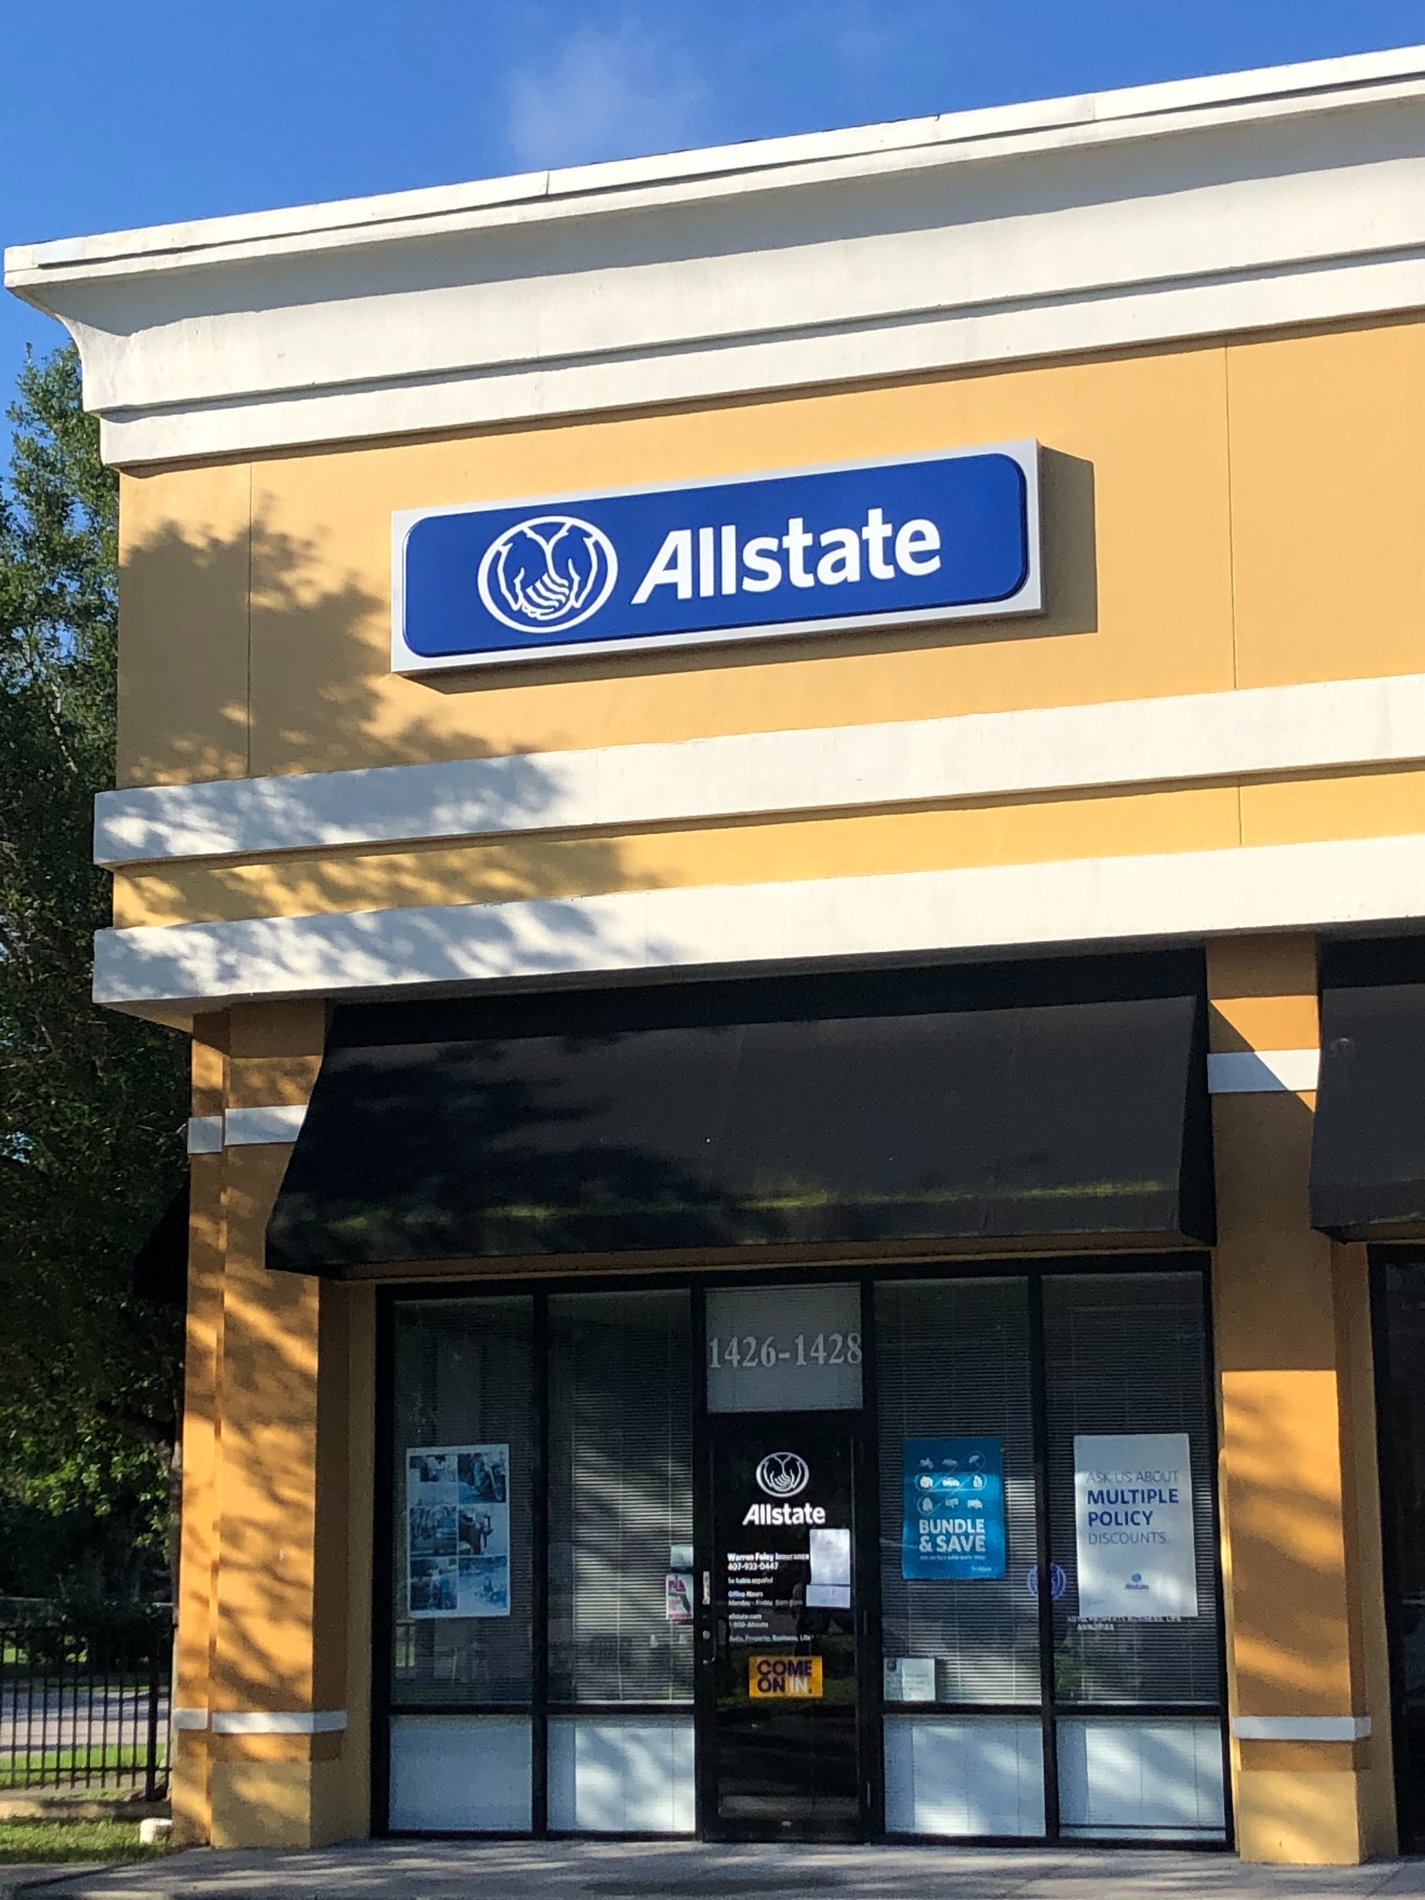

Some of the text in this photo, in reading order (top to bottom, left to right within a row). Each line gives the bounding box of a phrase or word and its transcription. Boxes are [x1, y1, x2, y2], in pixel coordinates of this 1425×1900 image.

[630, 507, 942, 605] Allstate
[709, 1333, 863, 1368] 1426-1428
[1087, 1470, 1178, 1484] ASK US ABOUT
[1087, 1488, 1180, 1505] MULTIPLE
[742, 1502, 826, 1526] Allstate
[1088, 1510, 1154, 1527] POLICY
[919, 1518, 986, 1534] BUNDLE
[919, 1534, 986, 1553] & SAVE
[757, 1659, 813, 1677] COME
[757, 1678, 786, 1693] ON
